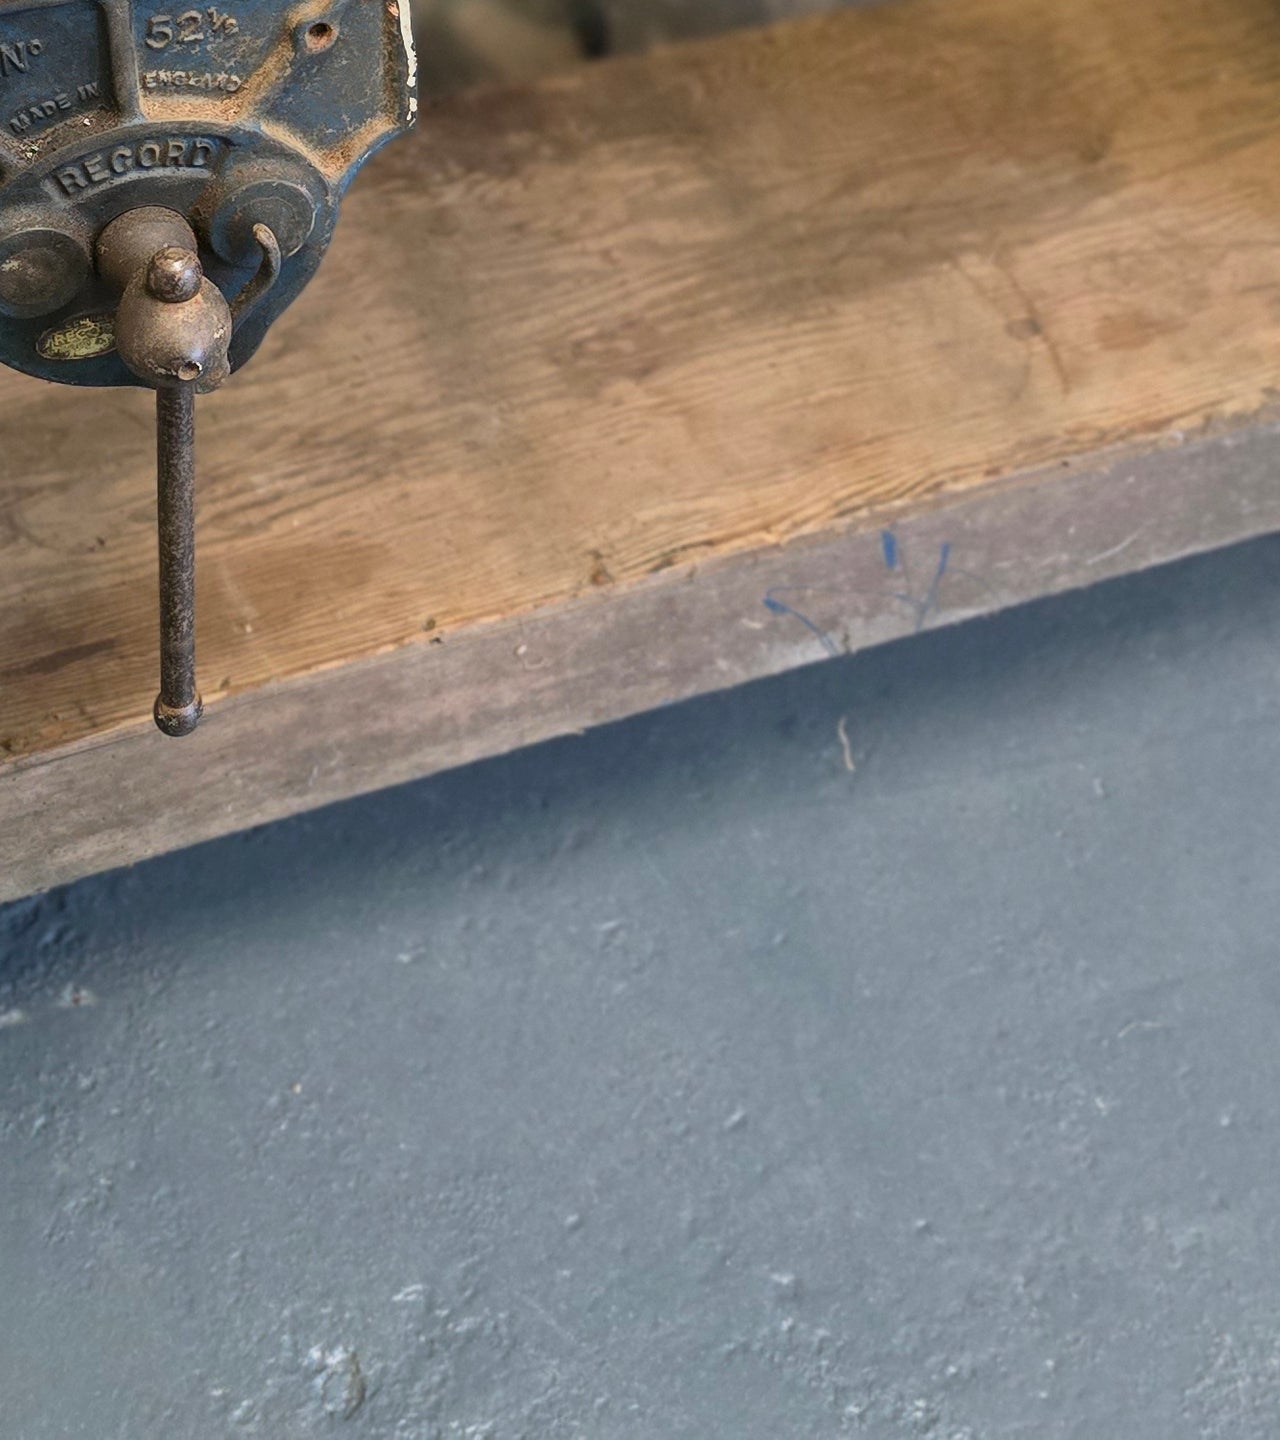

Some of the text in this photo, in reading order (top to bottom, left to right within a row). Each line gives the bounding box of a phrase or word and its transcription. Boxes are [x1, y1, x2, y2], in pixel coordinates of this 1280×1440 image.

[7, 68, 243, 135] MADE IN ENGLAND
[55, 137, 215, 197] RECORD
